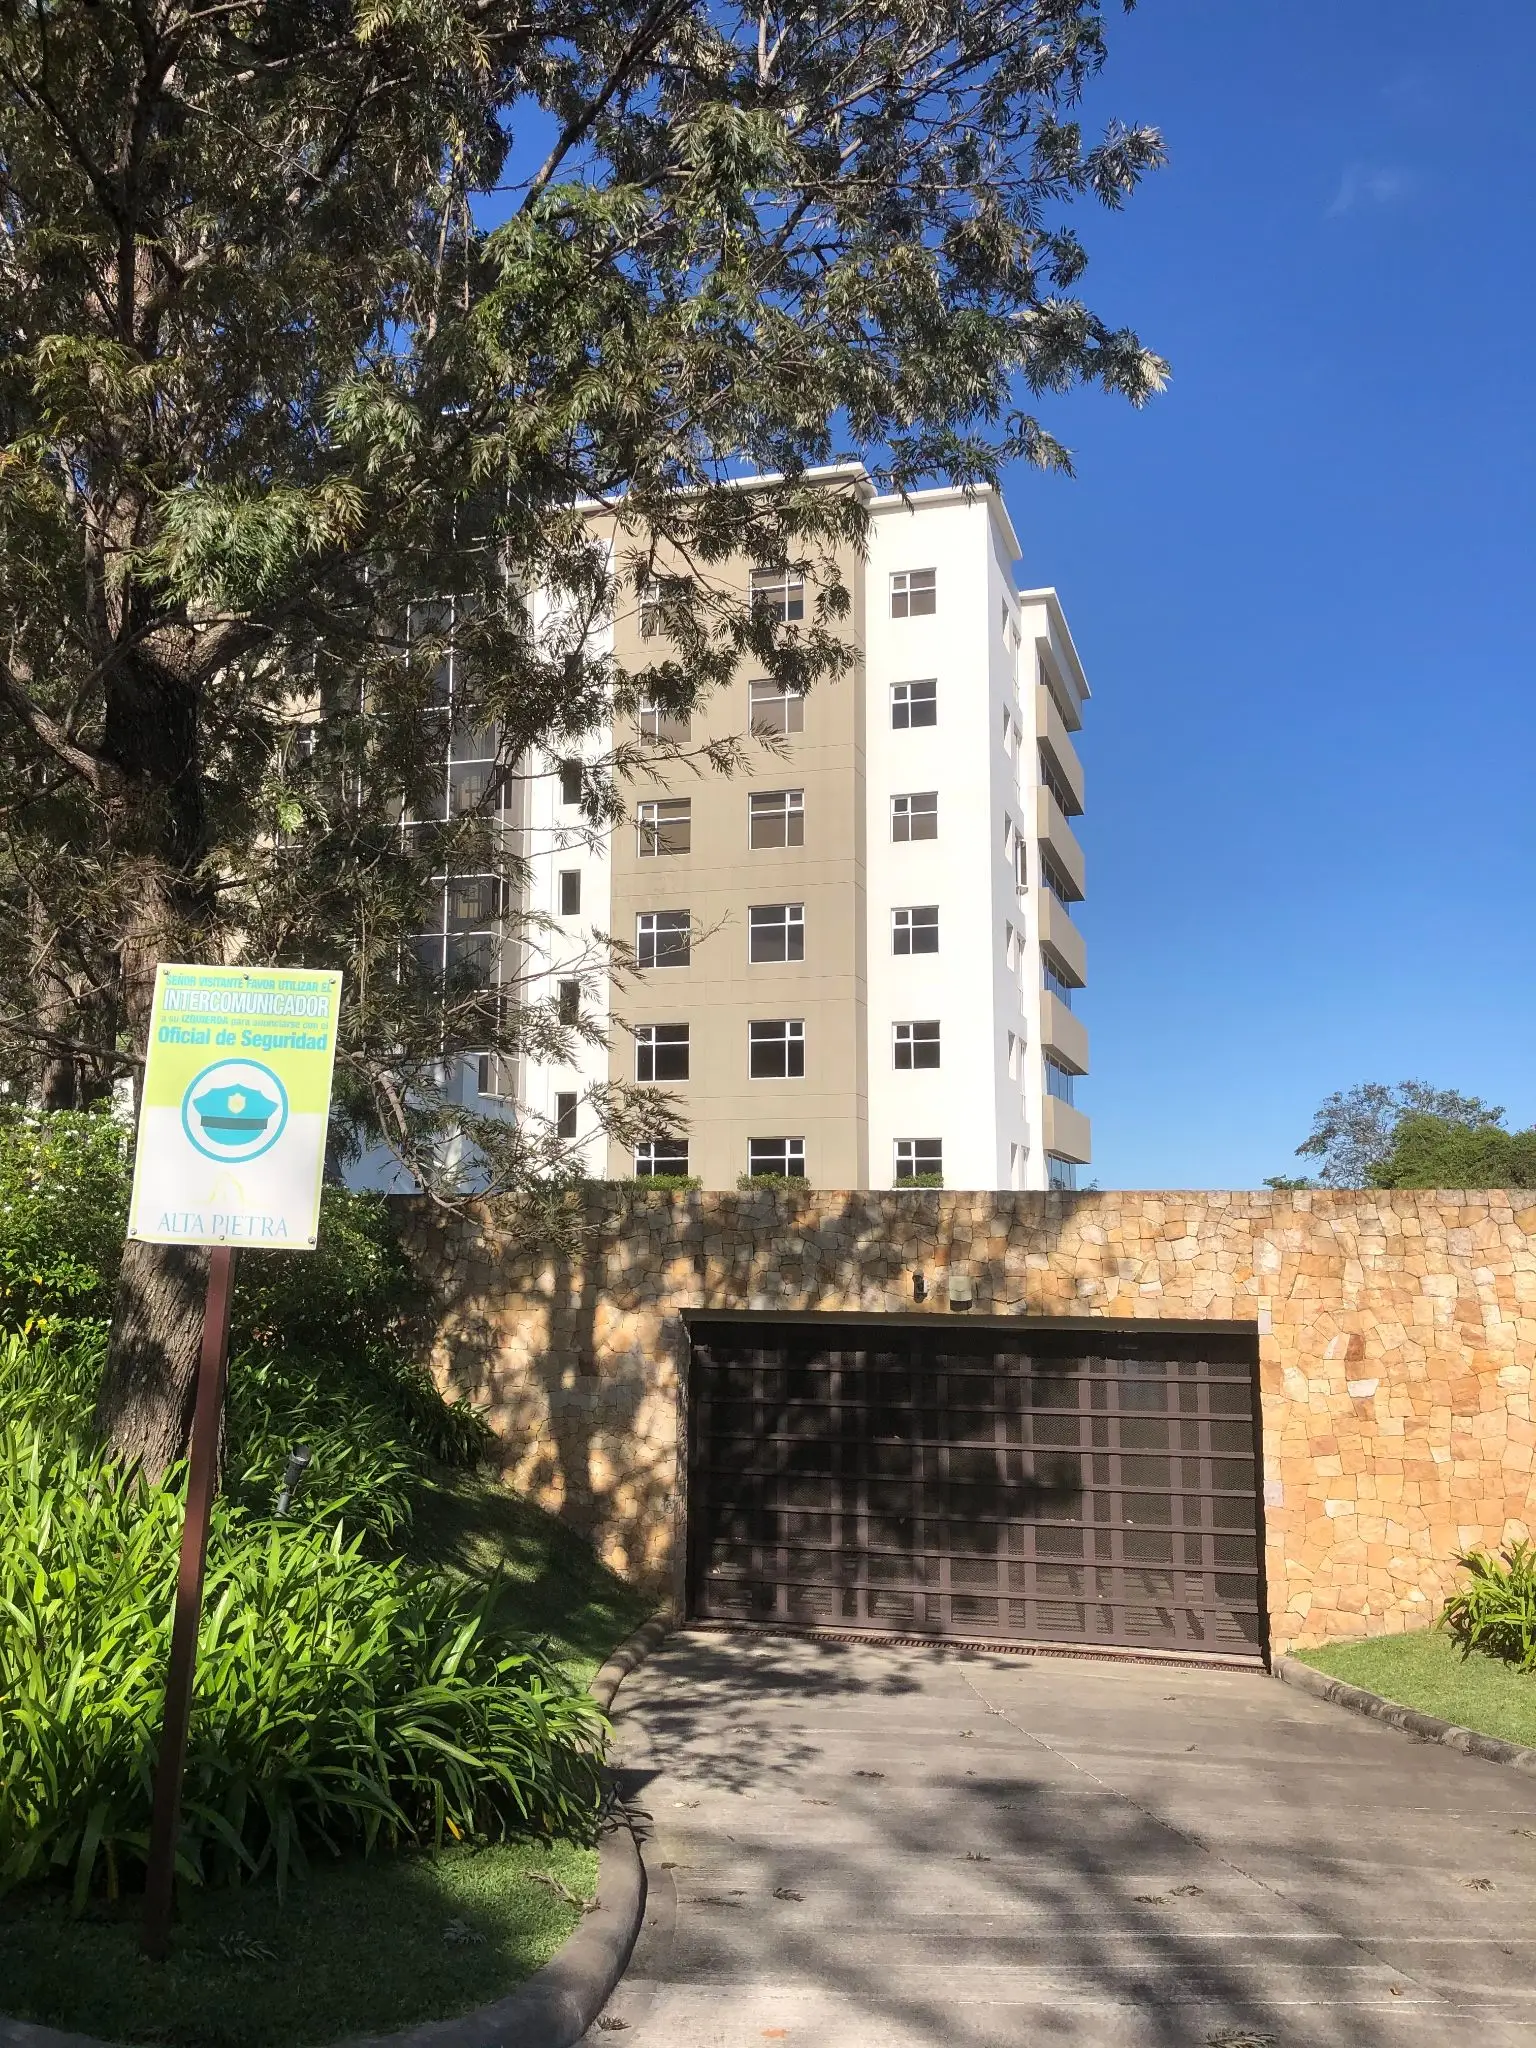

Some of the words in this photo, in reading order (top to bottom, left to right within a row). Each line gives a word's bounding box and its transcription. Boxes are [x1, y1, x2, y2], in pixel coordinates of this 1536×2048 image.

[166, 973, 196, 986] SEÑOR
[199, 976, 243, 989] VISITANTE
[247, 978, 275, 990] FAVOR
[278, 979, 318, 992] UTILIZAR
[320, 981, 332, 993] EL
[163, 988, 330, 1018] INTERCOMUNICADOR
[181, 1014, 229, 1026] IZQUIERDA
[231, 1018, 251, 1027] para
[158, 1026, 211, 1045] Oficial
[215, 1028, 237, 1046] de
[240, 1029, 328, 1052] Seguridad
[157, 1212, 204, 1234] ALTA
[211, 1214, 288, 1238] PIETRA
